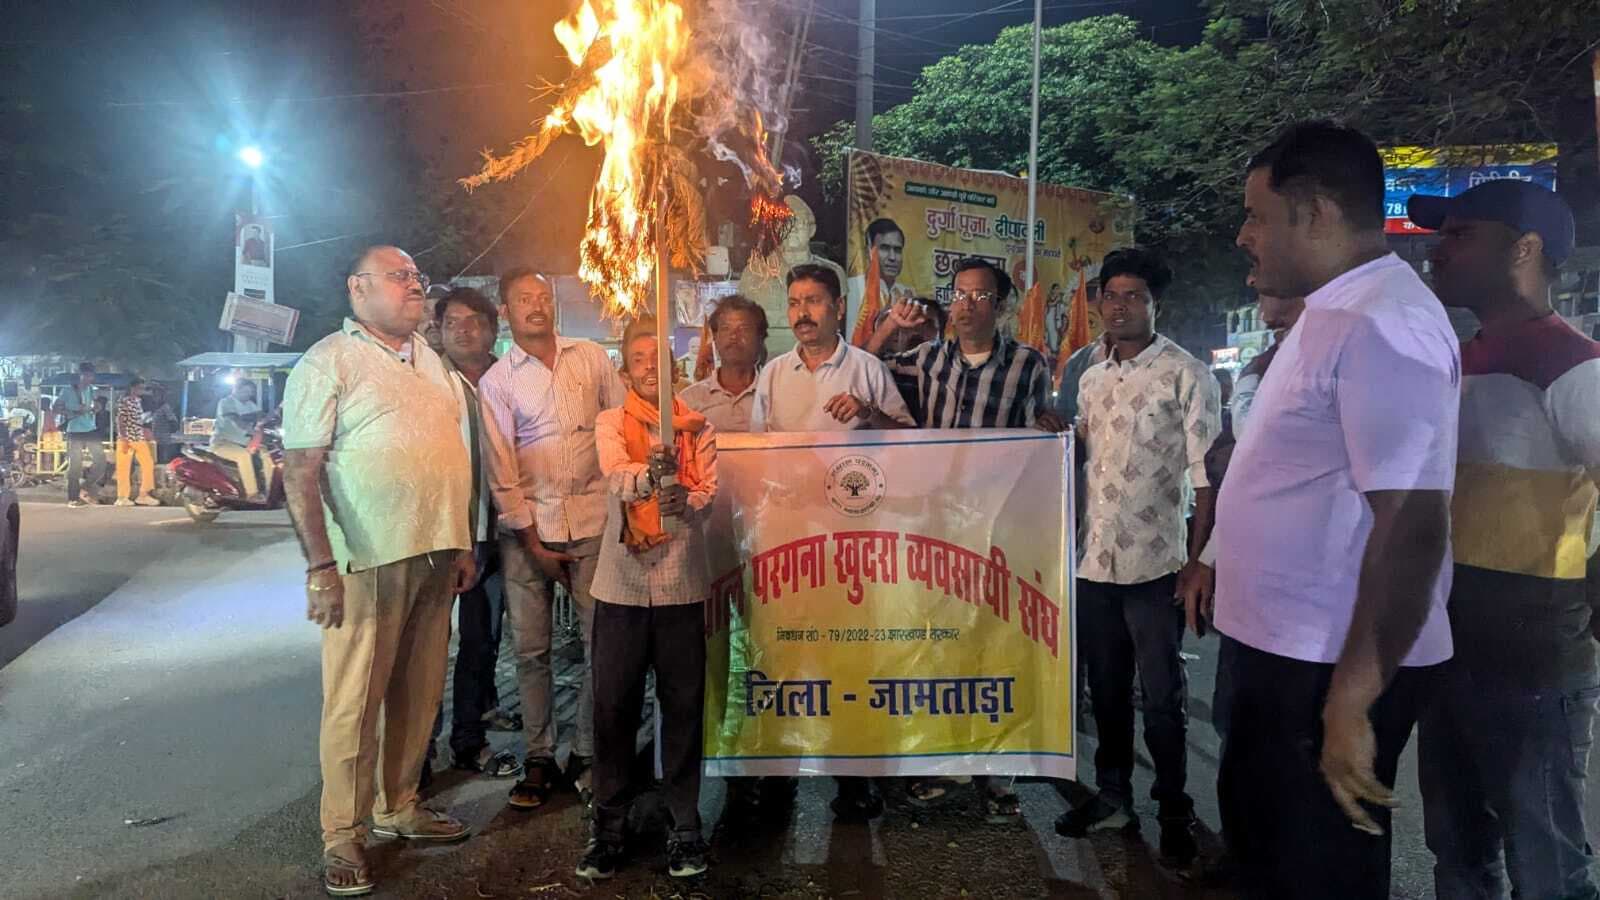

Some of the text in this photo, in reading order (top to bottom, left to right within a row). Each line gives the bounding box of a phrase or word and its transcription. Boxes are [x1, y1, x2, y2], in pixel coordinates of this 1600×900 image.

[752, 534, 827, 604] परगना
[832, 531, 899, 605] खुदरा
[905, 533, 1011, 623] व्यवसायी
[1017, 569, 1059, 659] संघ
[829, 628, 886, 641] 79/2022-23
[746, 670, 1015, 723] जिला - जामताड़ा
